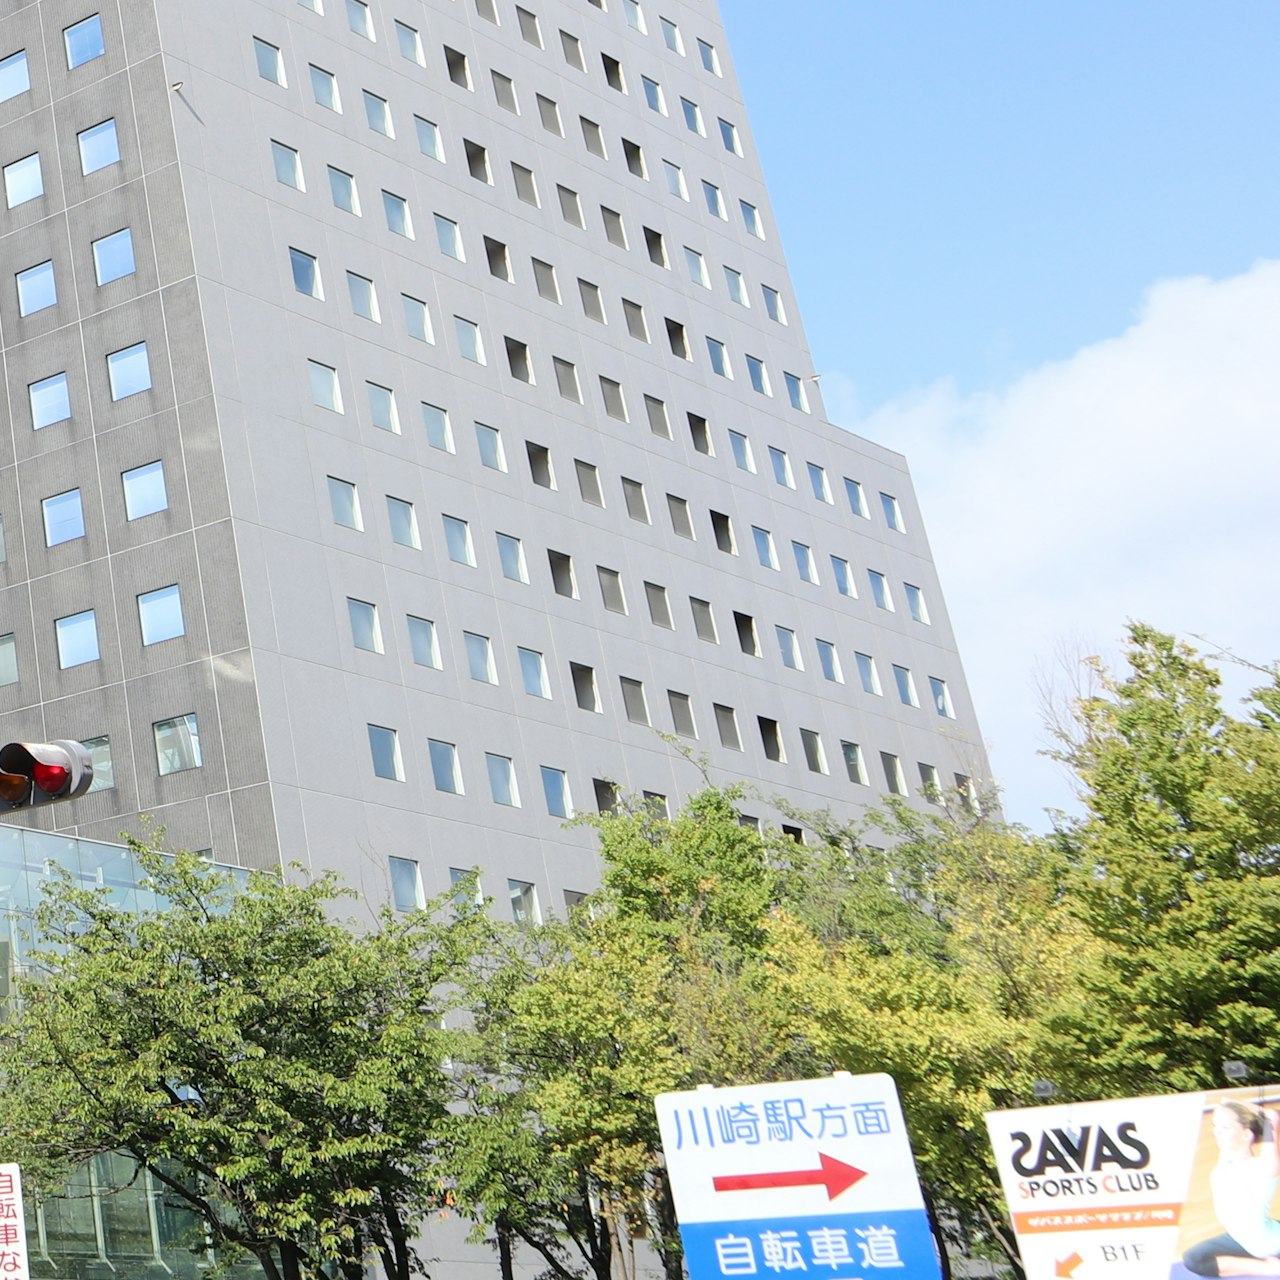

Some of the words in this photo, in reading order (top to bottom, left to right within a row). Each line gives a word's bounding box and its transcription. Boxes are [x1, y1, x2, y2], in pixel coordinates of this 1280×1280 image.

[673, 1097, 892, 1151] 川崎駅方面
[1009, 1121, 1151, 1178] SAVAS
[1018, 1176, 1098, 1199] SPORTS
[1102, 1172, 1160, 1194] CLUB
[714, 1224, 905, 1276] 自転車道
